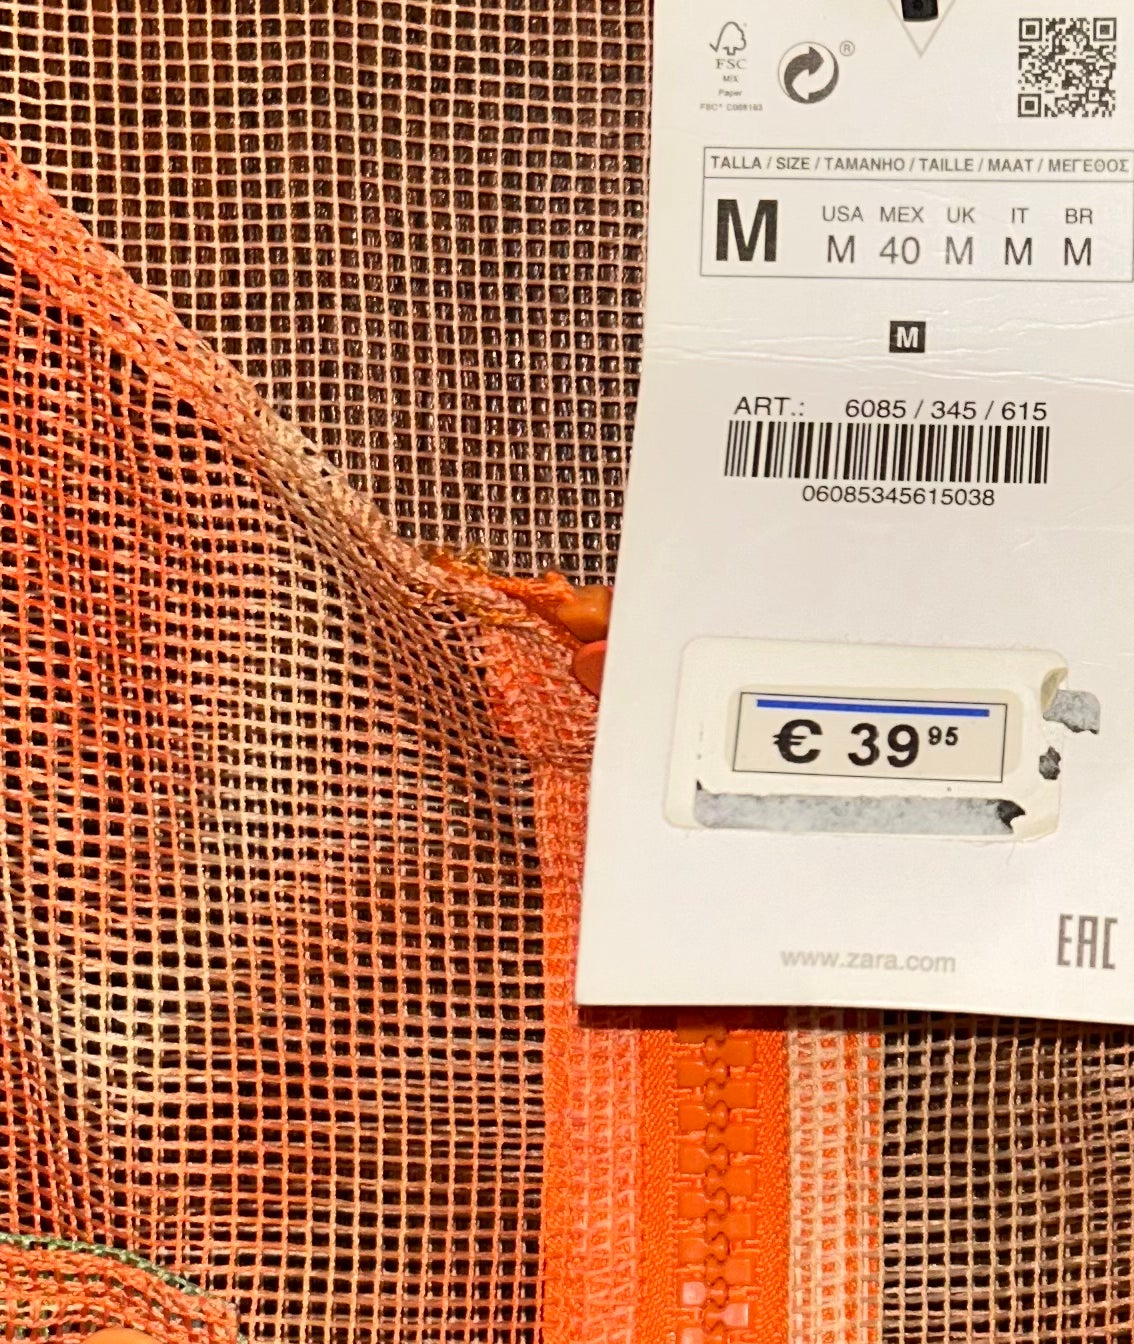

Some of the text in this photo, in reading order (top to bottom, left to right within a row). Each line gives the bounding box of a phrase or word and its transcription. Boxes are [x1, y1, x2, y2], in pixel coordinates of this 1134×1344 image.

[715, 58, 747, 70] FSC
[718, 89, 743, 97] Paper
[711, 155, 762, 170] TALLA
[776, 156, 811, 170] SIZE
[825, 157, 905, 172] TAMANHO
[919, 158, 974, 172] TAILLE
[988, 158, 1034, 172] MAAT
[822, 205, 1093, 224] USA MEX UK IT BR
[715, 198, 779, 262] M
[827, 235, 1092, 266] M 40 M M M
[896, 326, 918, 349] M
[734, 396, 804, 416] ART.:
[845, 399, 906, 419] 6085
[930, 401, 976, 420] 345
[1001, 402, 1046, 421] 615
[802, 485, 995, 507] 06085345615038
[780, 949, 956, 972] www.zara.com
